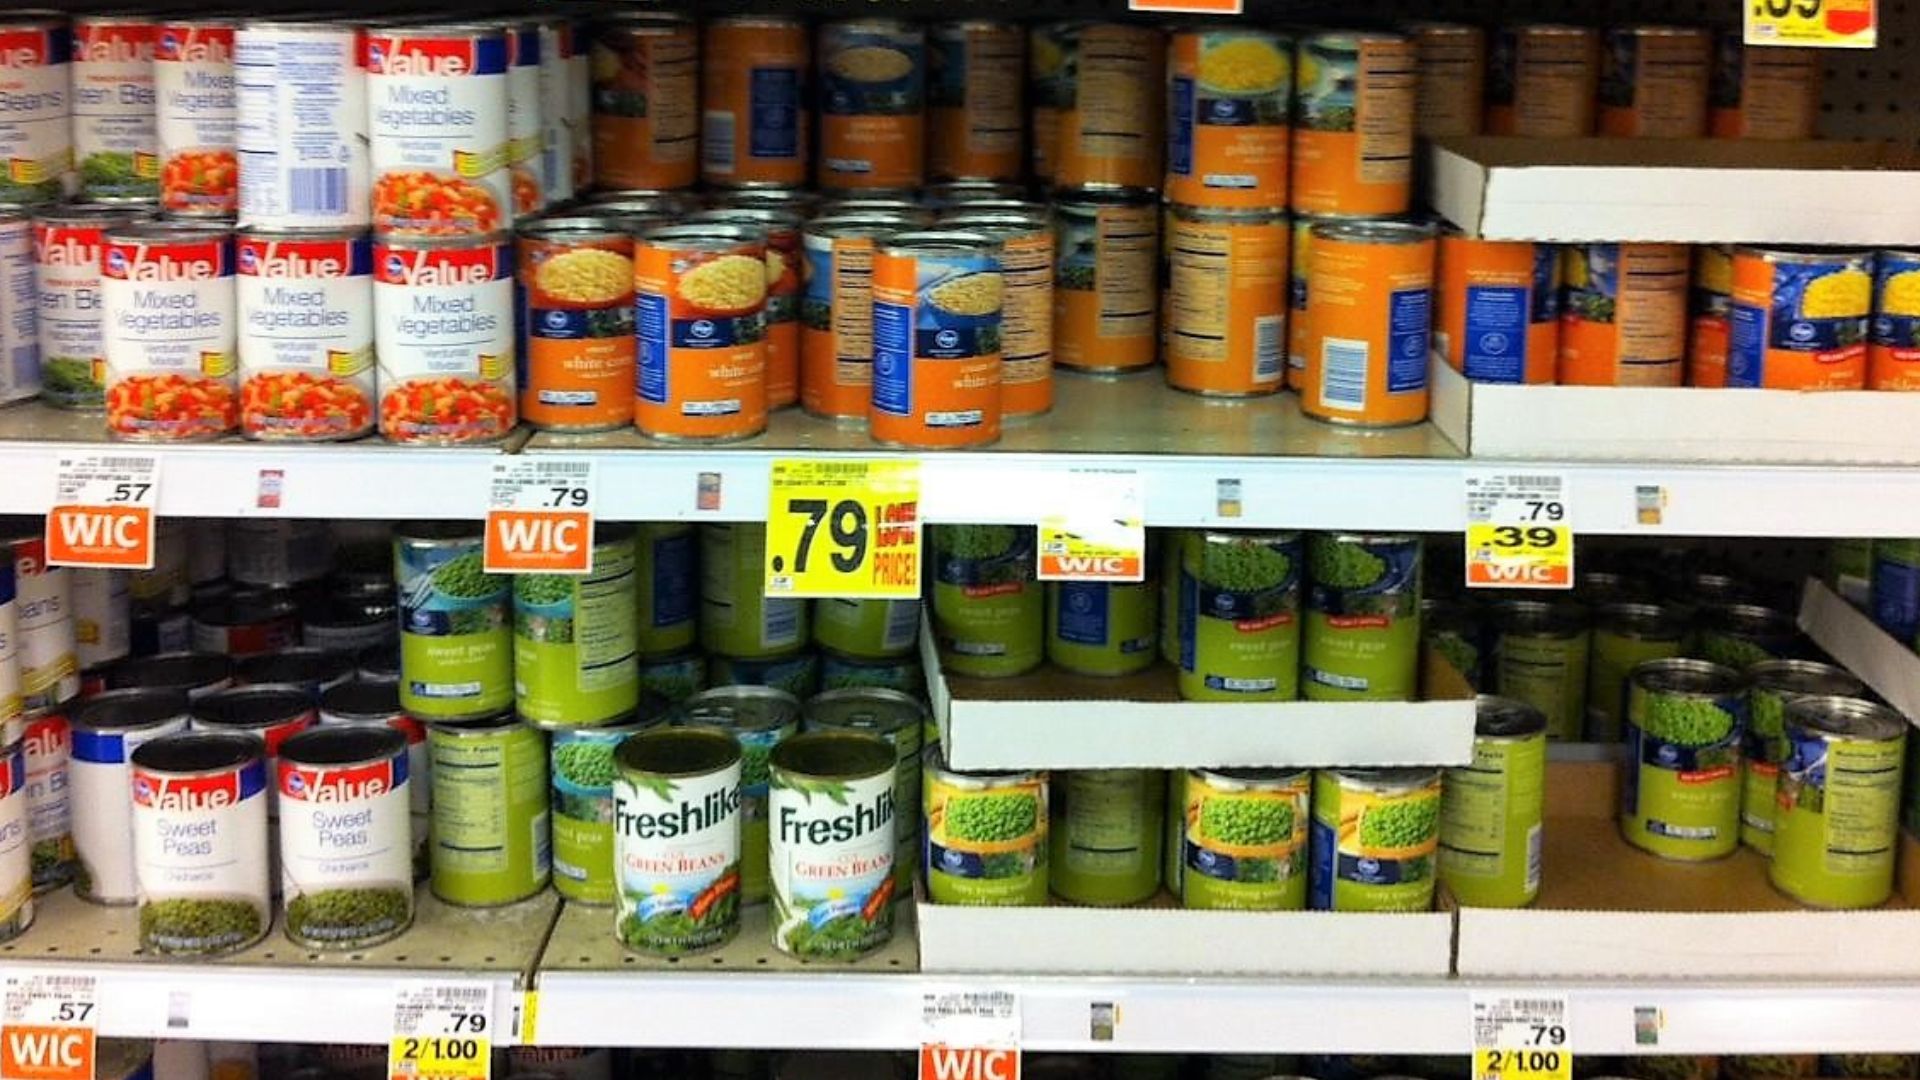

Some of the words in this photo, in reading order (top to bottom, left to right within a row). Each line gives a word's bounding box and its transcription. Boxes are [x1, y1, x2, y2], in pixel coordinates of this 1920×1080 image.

[380, 38, 467, 76] Value
[184, 73, 237, 89] Mixe
[388, 86, 448, 104] Mixed
[39, 228, 99, 266] Valu
[124, 245, 212, 282] Value
[256, 242, 341, 277] Value
[404, 250, 490, 286] Value
[134, 291, 196, 309] Mixed
[264, 287, 325, 306] Mixed
[413, 296, 475, 313] Mixed
[115, 310, 221, 334] Vegetables
[248, 309, 349, 331] Vegetables
[396, 313, 498, 338] Vegetables
[105, 483, 151, 501] .57
[543, 488, 588, 507] .79
[1519, 501, 1564, 521] .79
[59, 512, 140, 549] WIC
[499, 519, 578, 553] WIC
[772, 499, 868, 573] .79
[1481, 526, 1557, 548] .39
[1057, 557, 1124, 573] WIC
[1485, 564, 1554, 581] WIC
[152, 777, 230, 812] Value
[305, 771, 384, 803] Value
[312, 808, 373, 829] Sweet
[616, 777, 741, 840] Freshlike
[781, 786, 894, 846] Freshlik
[157, 818, 216, 837] Sweet
[163, 838, 212, 856] Peas
[319, 831, 367, 848] Peas
[51, 1002, 94, 1021] .57
[443, 1012, 486, 1033] .79
[1524, 1025, 1566, 1045] .79
[9, 1032, 83, 1067] WIC
[403, 1038, 477, 1060] 2/1.00
[931, 1047, 1008, 1080] WIC
[1487, 1050, 1559, 1072] 2/1.00
